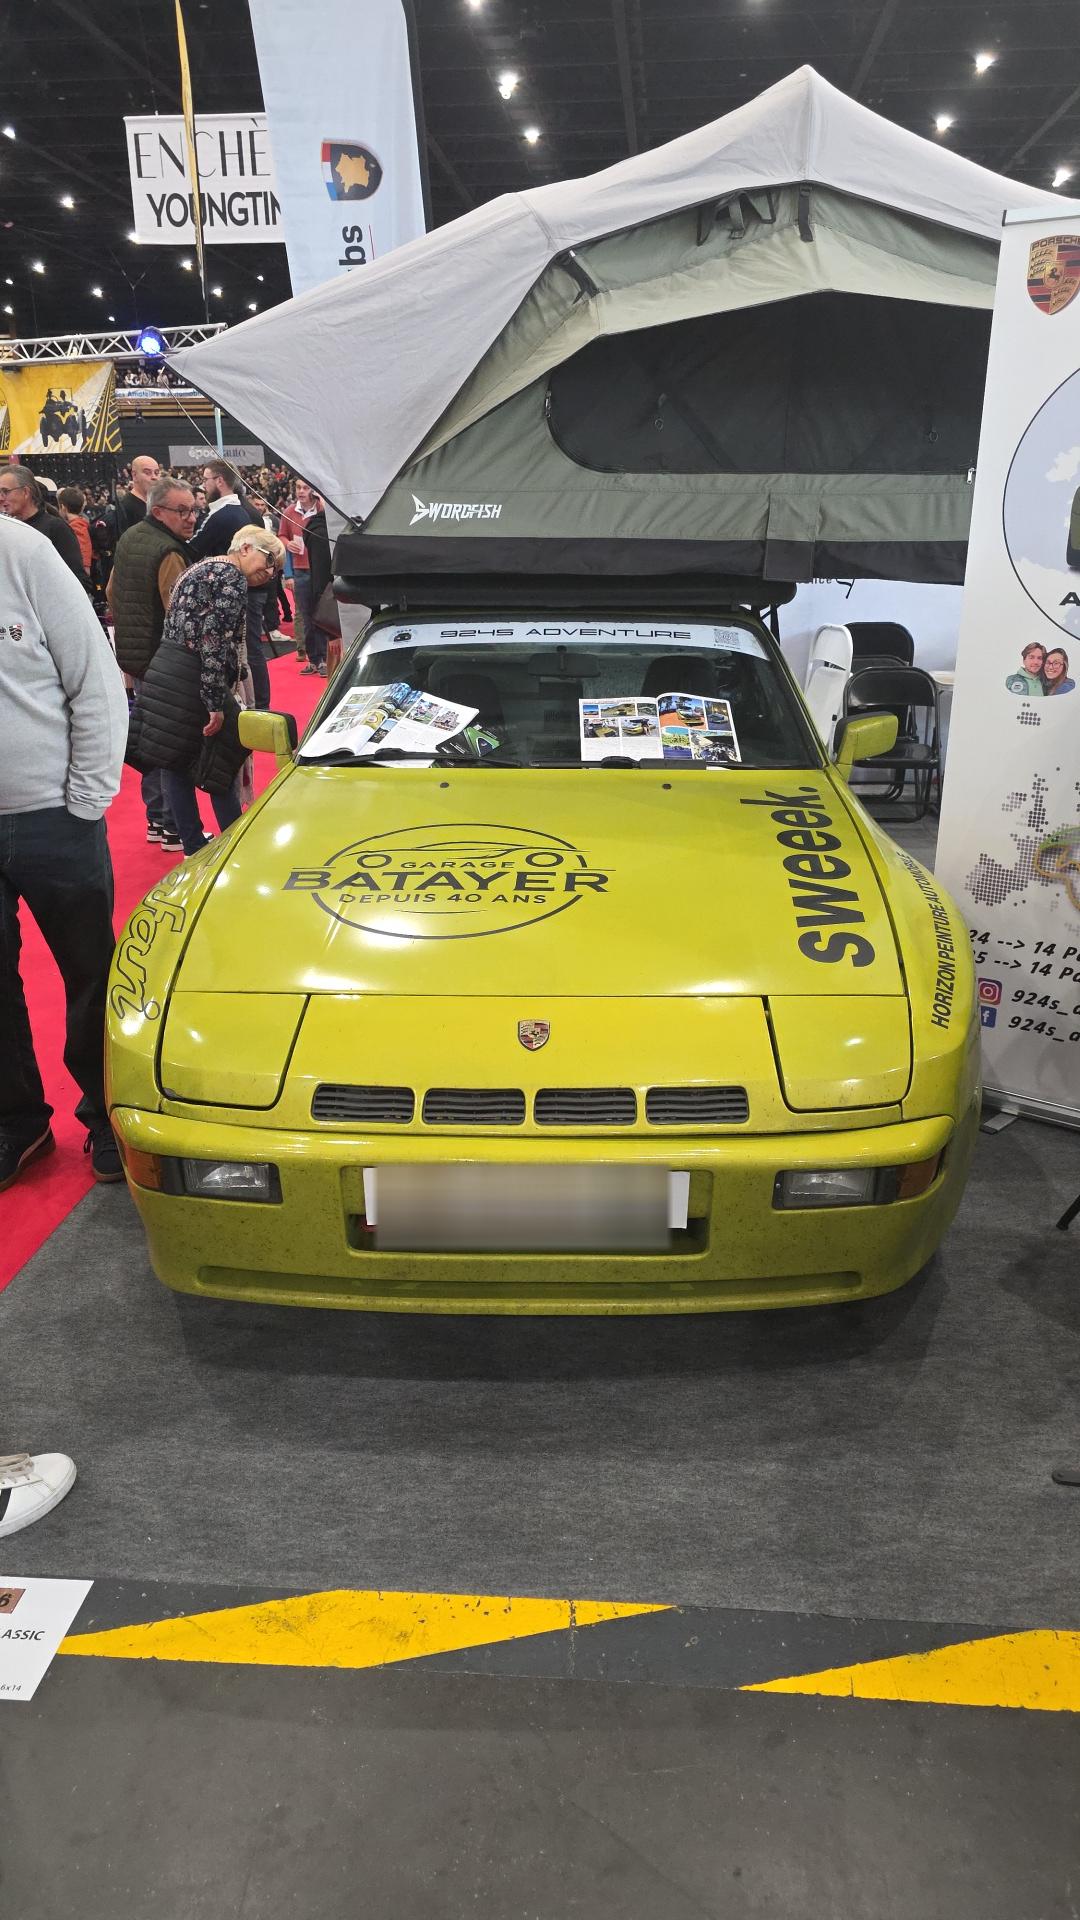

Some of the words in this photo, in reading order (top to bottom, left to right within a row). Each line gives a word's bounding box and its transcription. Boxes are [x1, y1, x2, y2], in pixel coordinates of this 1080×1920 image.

[339, 225, 366, 266] bs
[409, 493, 502, 525] SWORDFISH
[526, 628, 691, 640] ADVENTURE
[400, 861, 515, 870] GARAGE
[740, 786, 875, 967] sweek.
[281, 870, 609, 893] BATAYER
[339, 893, 435, 904] DEPUIS
[447, 893, 482, 903] 40
[491, 894, 547, 904] ANS
[929, 902, 955, 962] PEINTURE
[1034, 941, 1056, 956] 14
[1030, 961, 1053, 976] 14
[931, 961, 956, 1030] HORIZON
